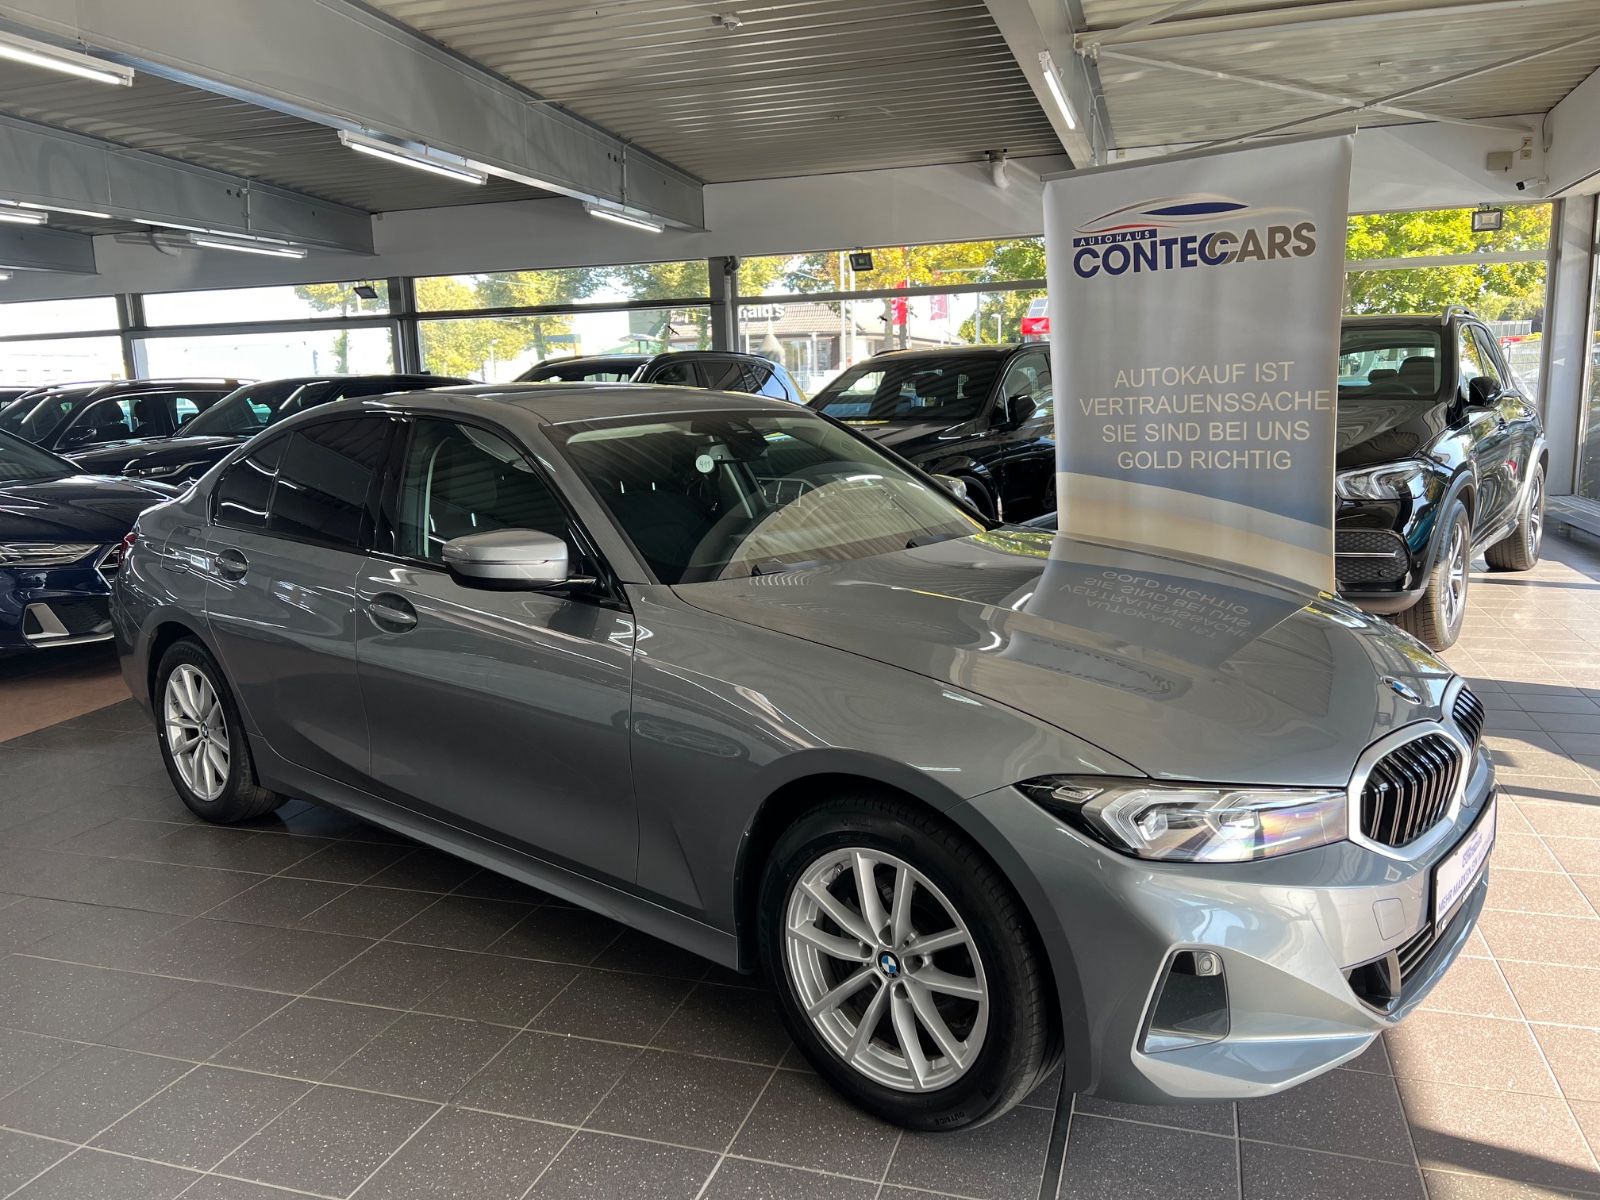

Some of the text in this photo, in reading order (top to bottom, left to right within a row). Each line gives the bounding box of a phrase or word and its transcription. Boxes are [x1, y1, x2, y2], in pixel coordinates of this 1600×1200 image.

[1079, 230, 1151, 246] AUTOHAUS
[1114, 361, 1295, 388] AUTOKAUF IST
[1102, 420, 1311, 443] SIE SIND BEI UNS
[1117, 449, 1292, 470] GOLD RICHTIG
[1438, 888, 1453, 915] MEHR
